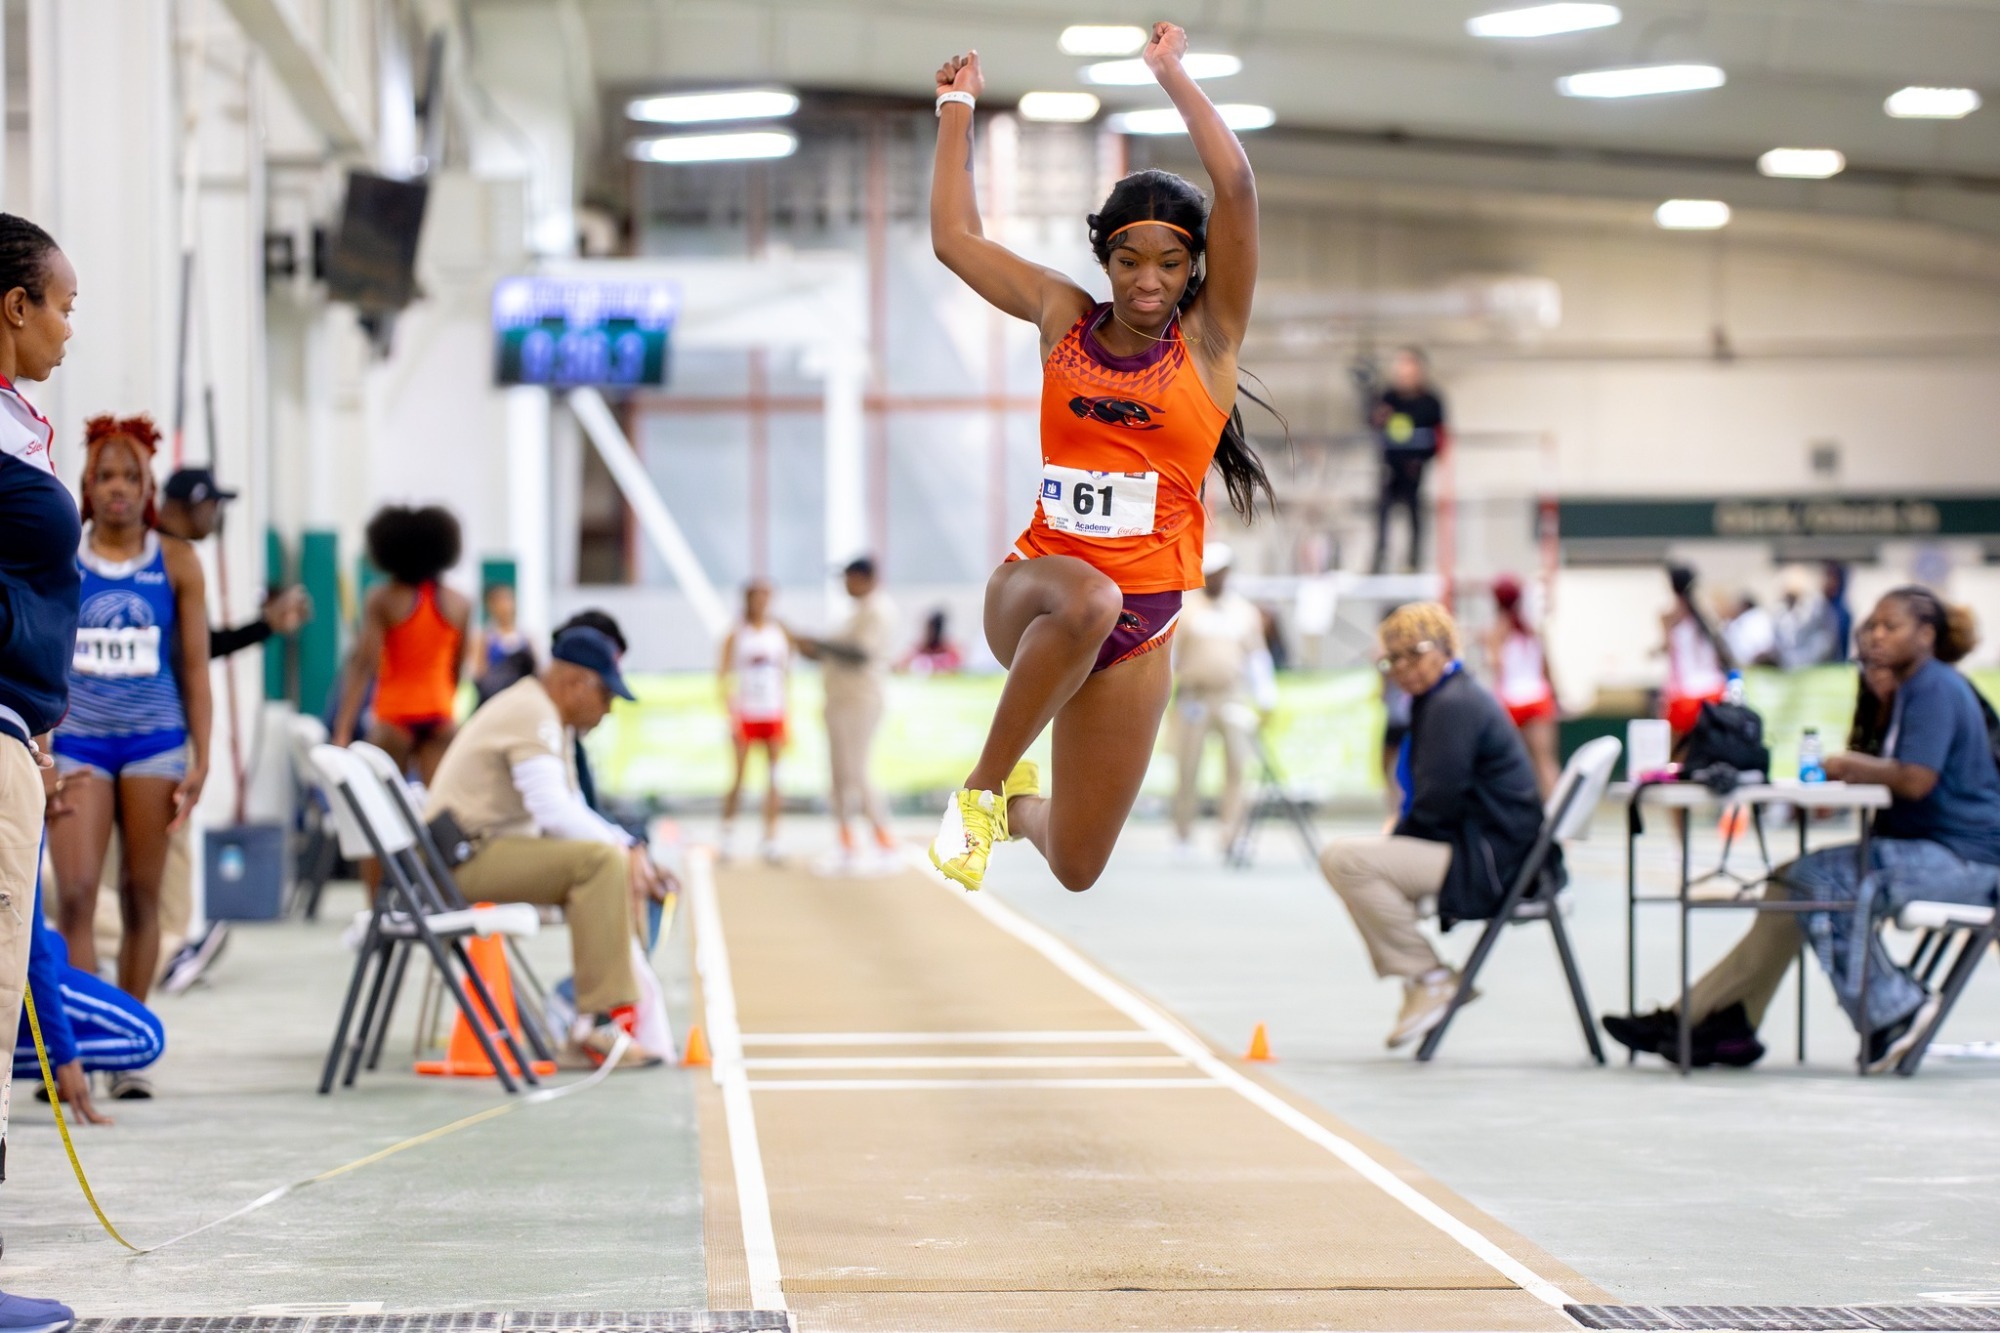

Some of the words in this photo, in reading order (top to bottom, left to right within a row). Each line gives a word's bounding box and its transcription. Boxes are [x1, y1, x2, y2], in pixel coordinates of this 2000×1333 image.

[1073, 482, 1113, 517] 61
[1075, 521, 1112, 533] Academy
[95, 641, 136, 661] 101
